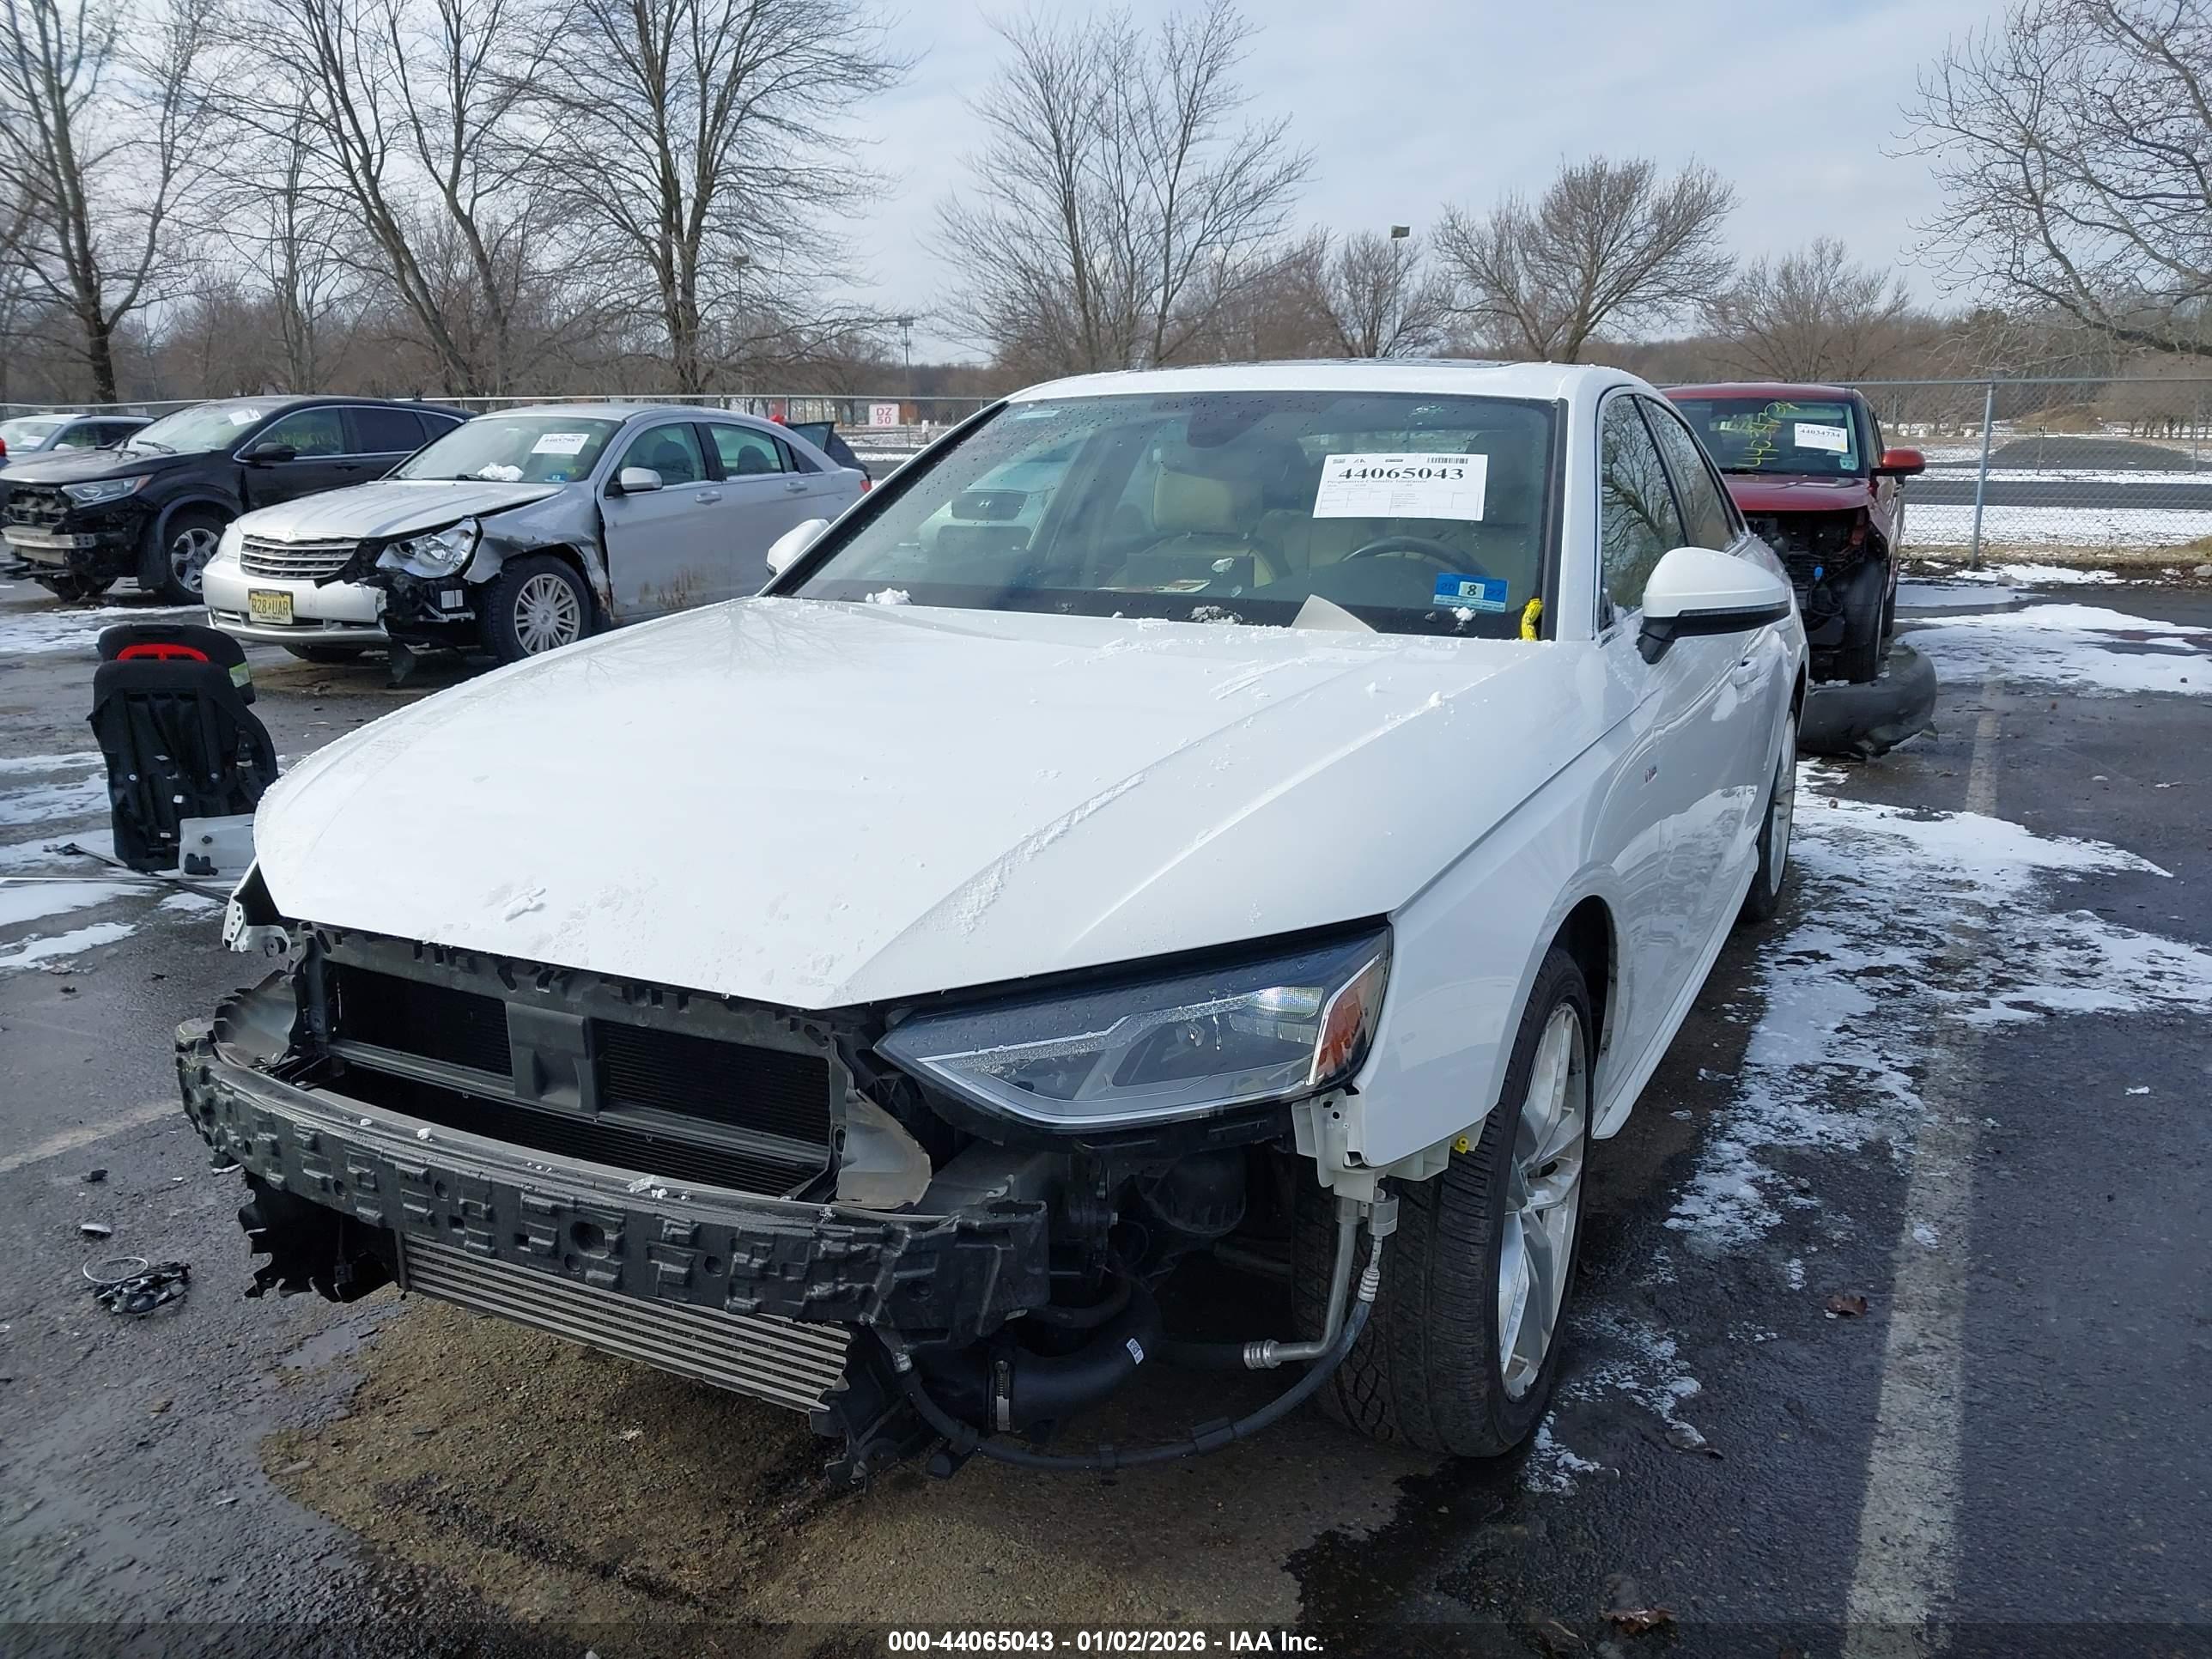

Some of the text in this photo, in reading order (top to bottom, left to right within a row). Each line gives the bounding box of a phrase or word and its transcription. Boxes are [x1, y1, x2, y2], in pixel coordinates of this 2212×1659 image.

[876, 407, 892, 416] DZ
[1338, 467, 1464, 480] 44065043
[1467, 584, 1477, 596] 8
